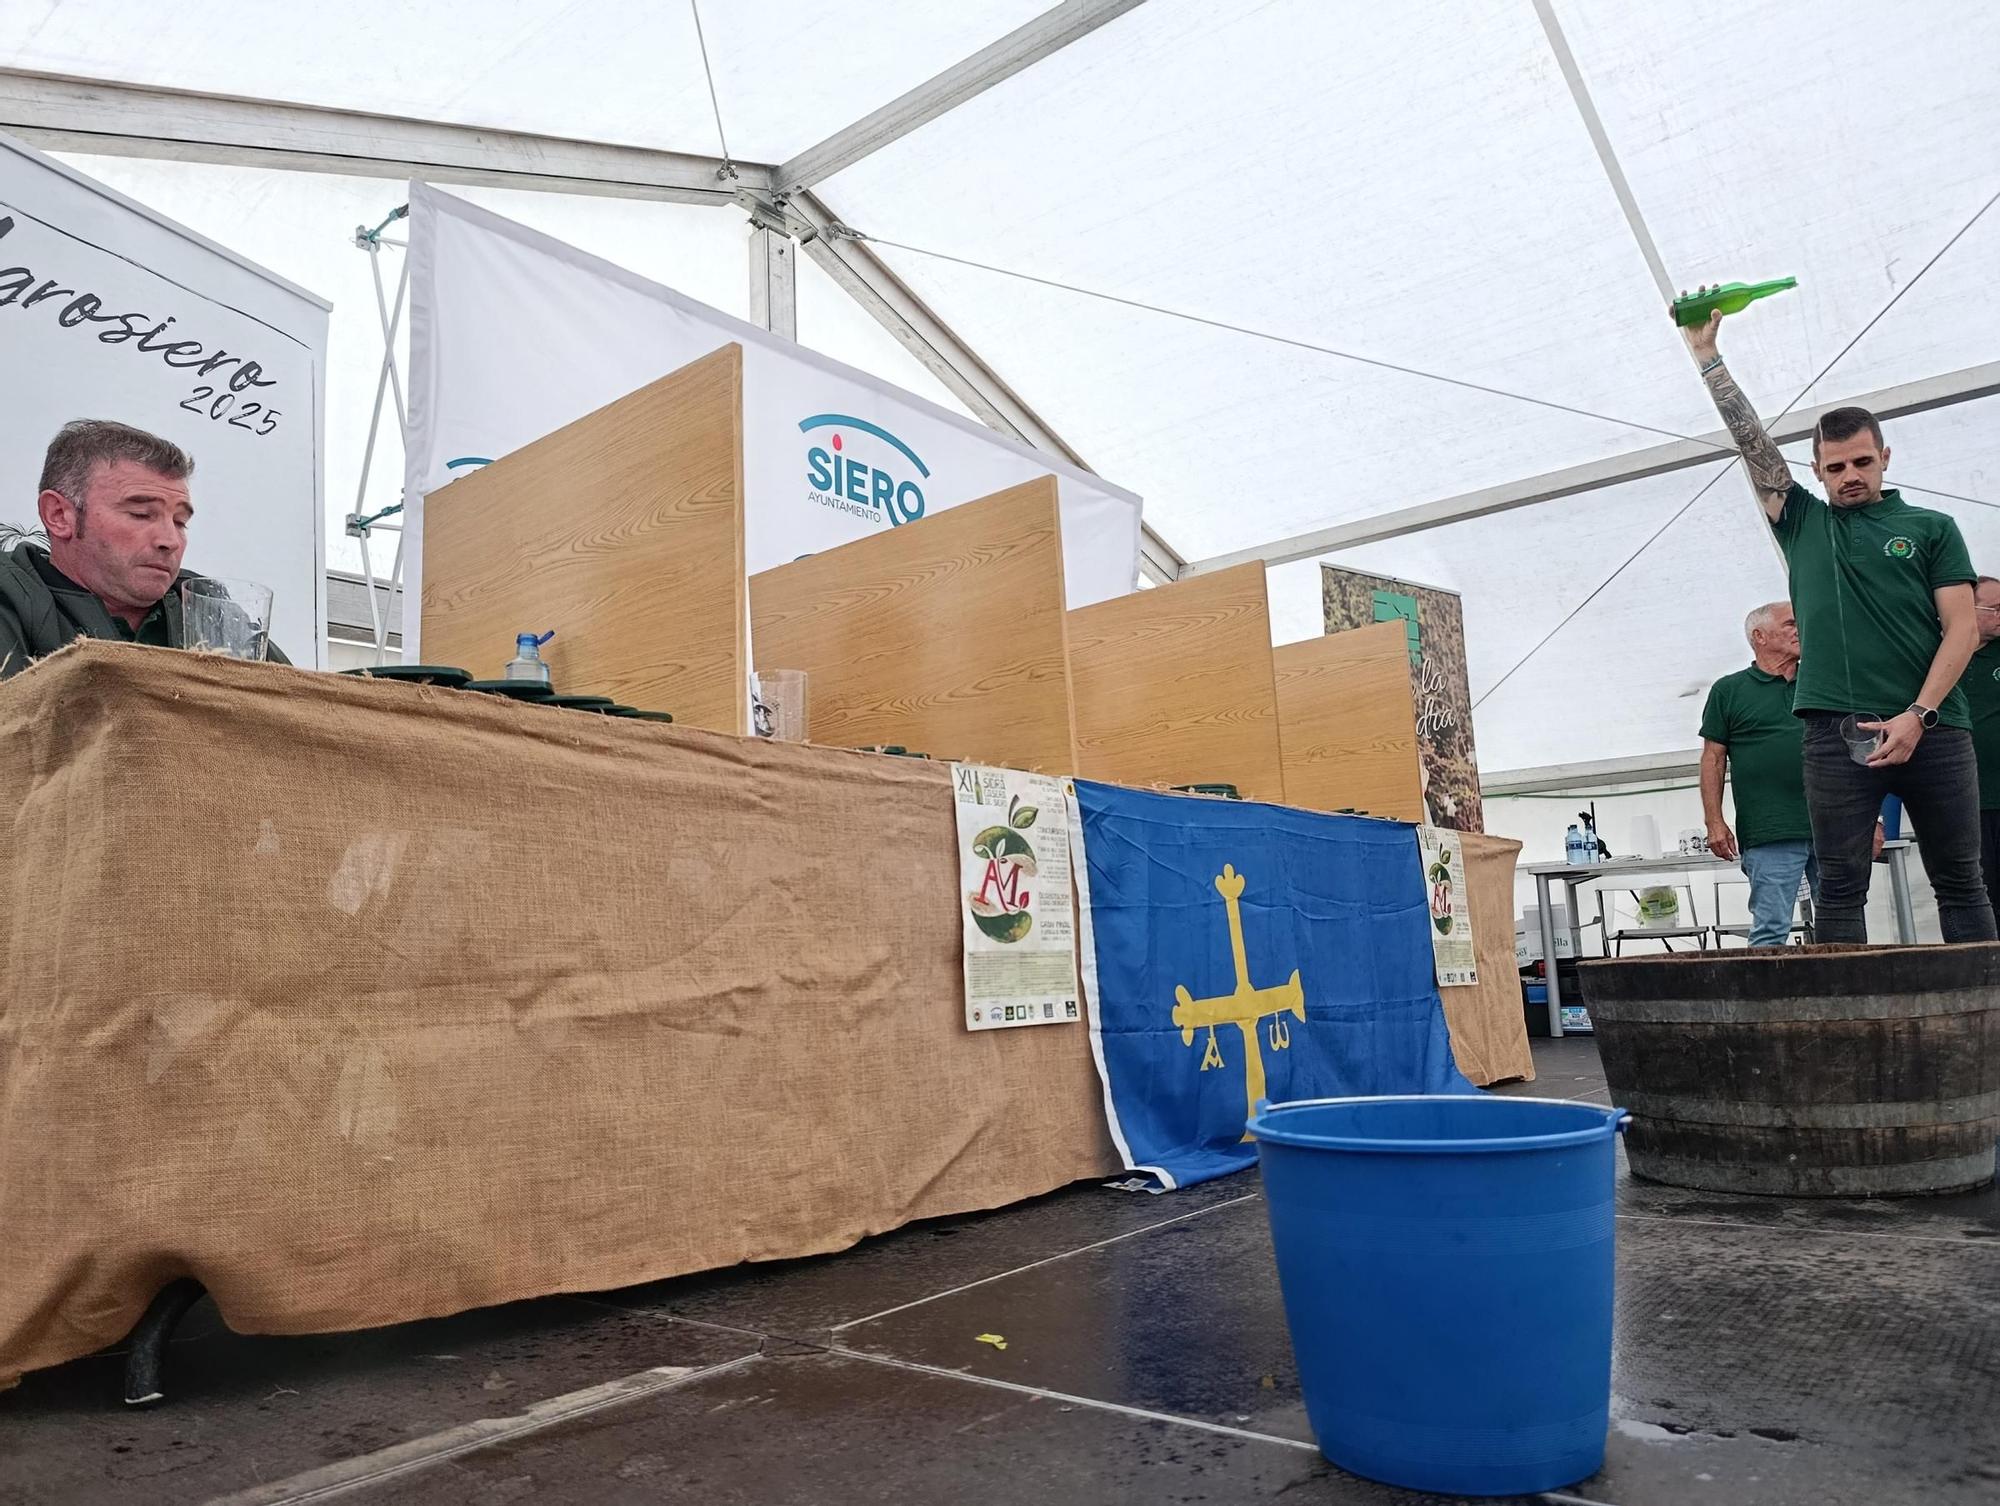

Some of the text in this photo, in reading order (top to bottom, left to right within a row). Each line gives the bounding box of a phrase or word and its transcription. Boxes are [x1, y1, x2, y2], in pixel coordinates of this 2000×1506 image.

[0, 214, 276, 392] grosiero
[180, 386, 281, 435] 2025
[808, 492, 881, 523] AYUNTAMIENTO
[1422, 657, 1448, 694] la
[1416, 697, 1457, 738] dra
